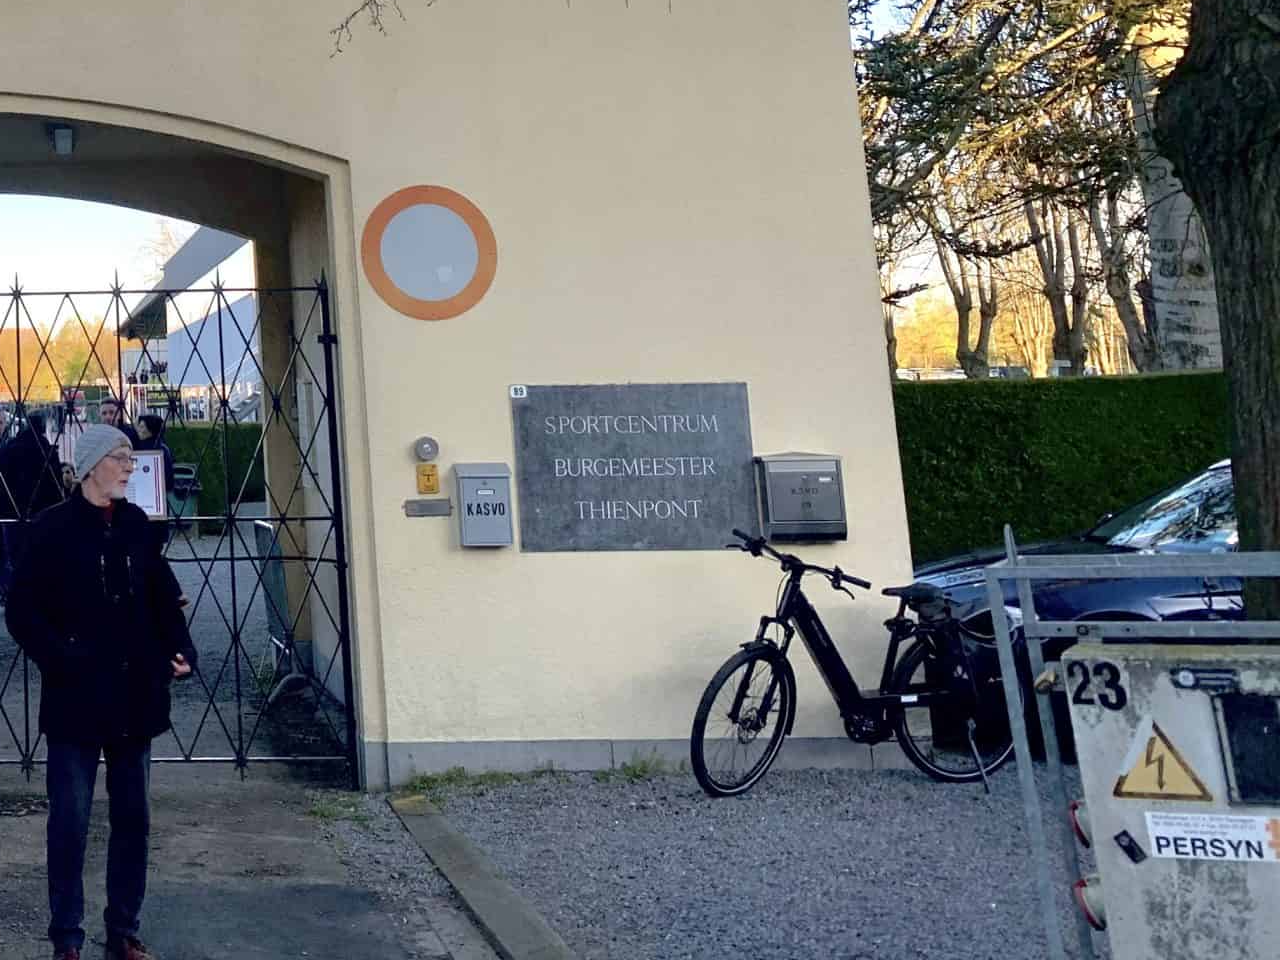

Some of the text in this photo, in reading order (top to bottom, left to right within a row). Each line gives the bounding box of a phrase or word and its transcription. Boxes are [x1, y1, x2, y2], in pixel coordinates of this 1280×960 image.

[544, 414, 719, 435] SPORTCENTRUM
[554, 456, 717, 478] BURGEMEESTER
[466, 502, 506, 516] KASVO
[574, 499, 703, 521] THIENPONT
[1067, 661, 1127, 710] 23
[1155, 836, 1264, 858] PERSYN
